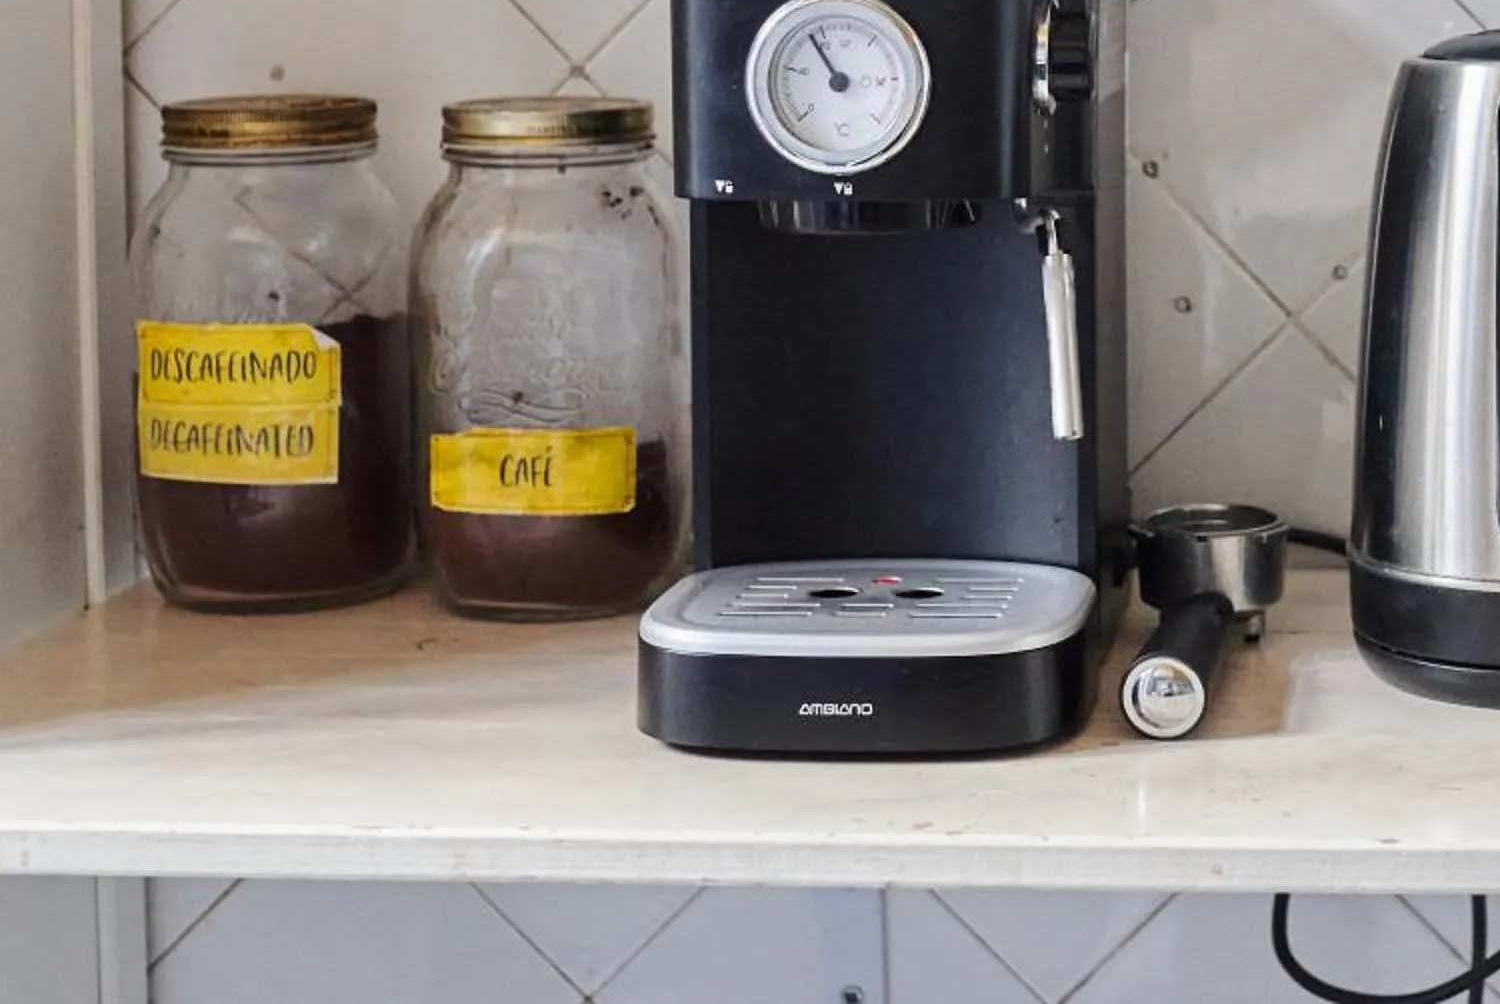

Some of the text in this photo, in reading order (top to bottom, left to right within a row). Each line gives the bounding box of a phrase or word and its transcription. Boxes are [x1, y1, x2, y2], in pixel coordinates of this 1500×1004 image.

[151, 347, 317, 384] DESCAFEINADO
[151, 418, 314, 458] DECAFEINATED
[500, 446, 555, 488] CAFÉ
[799, 702, 873, 715] AMBIANO
